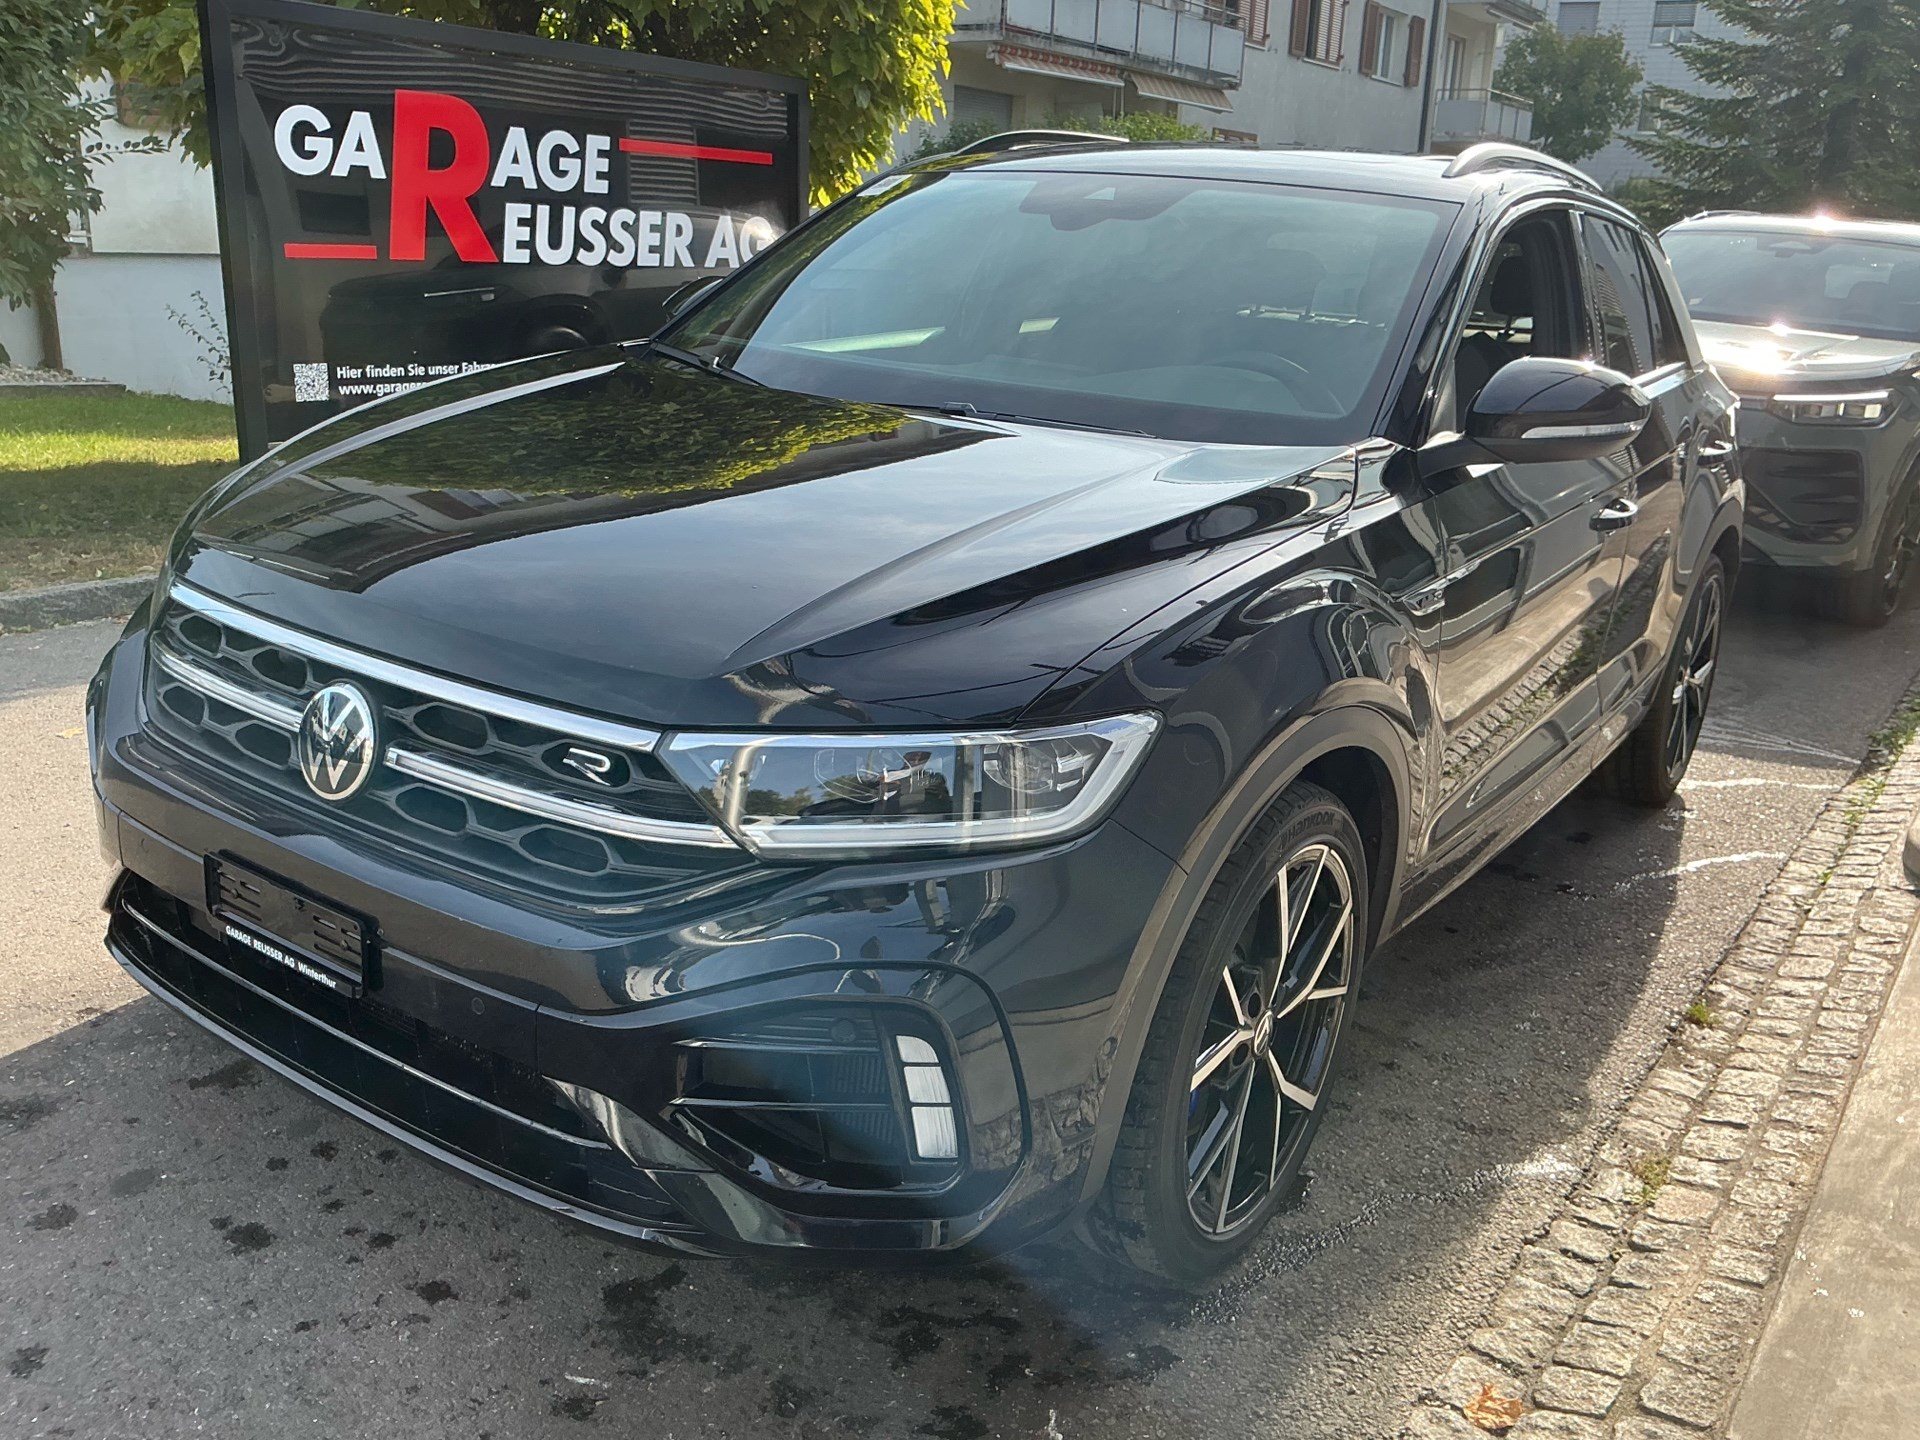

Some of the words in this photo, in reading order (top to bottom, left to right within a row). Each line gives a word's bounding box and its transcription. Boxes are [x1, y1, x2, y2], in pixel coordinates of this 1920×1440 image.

[274, 89, 611, 263] GARAGE
[704, 215, 776, 269] AG
[336, 366, 362, 379] Hier
[366, 364, 405, 378] finden
[408, 363, 426, 376] Sie
[428, 363, 459, 375] unser
[563, 747, 611, 786] R
[225, 925, 251, 946] GARAGE
[253, 939, 283, 962] REUSSER
[284, 954, 295, 968] AG
[297, 961, 337, 989] Winterthur
